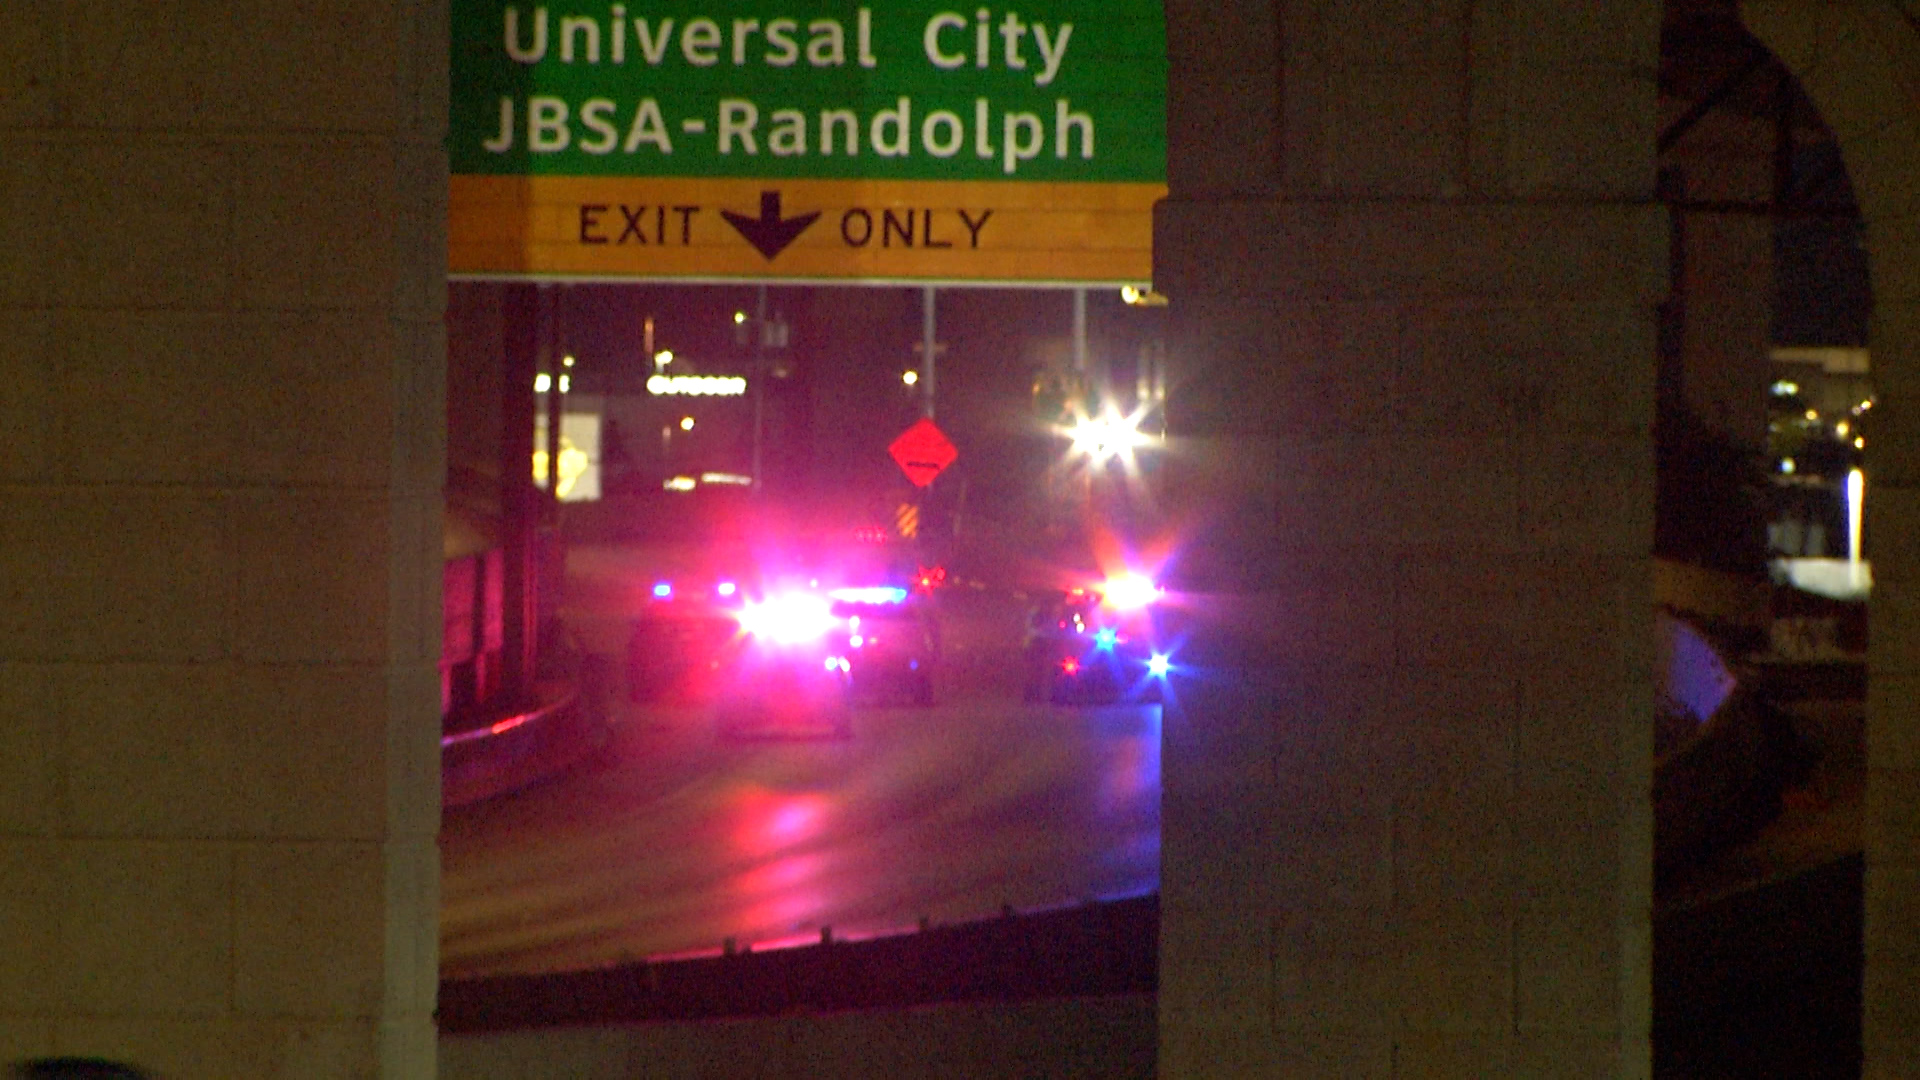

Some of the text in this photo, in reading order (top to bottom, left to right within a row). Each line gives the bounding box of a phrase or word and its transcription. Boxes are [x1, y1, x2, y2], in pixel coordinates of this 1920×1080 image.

[504, 4, 1074, 87] Universal City
[483, 96, 1095, 175] JBSA-Randolph
[578, 203, 993, 249] EXIT ONLY
